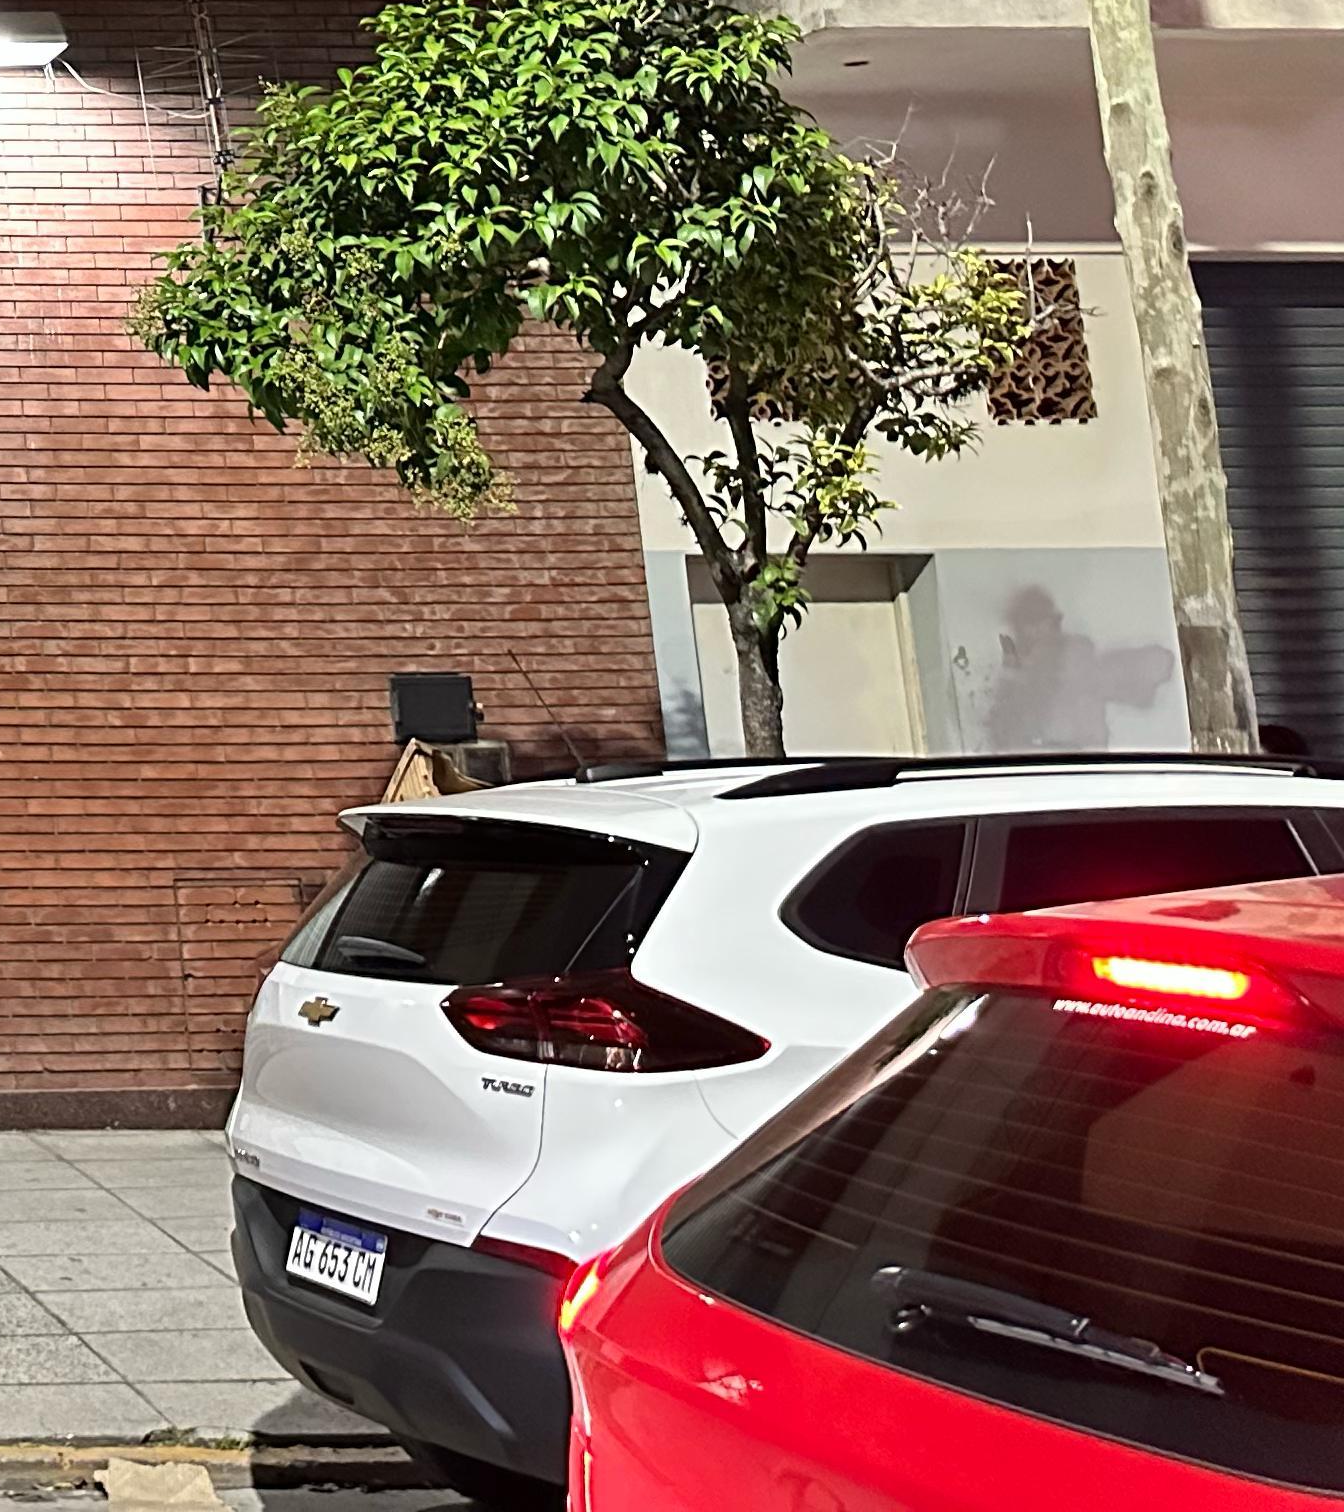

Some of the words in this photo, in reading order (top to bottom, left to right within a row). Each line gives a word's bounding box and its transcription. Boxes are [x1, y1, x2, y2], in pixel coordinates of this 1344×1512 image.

[1052, 999, 1257, 1038] www.autoandina.com.ar
[291, 1230, 318, 1269] AG
[318, 1239, 353, 1282] 653
